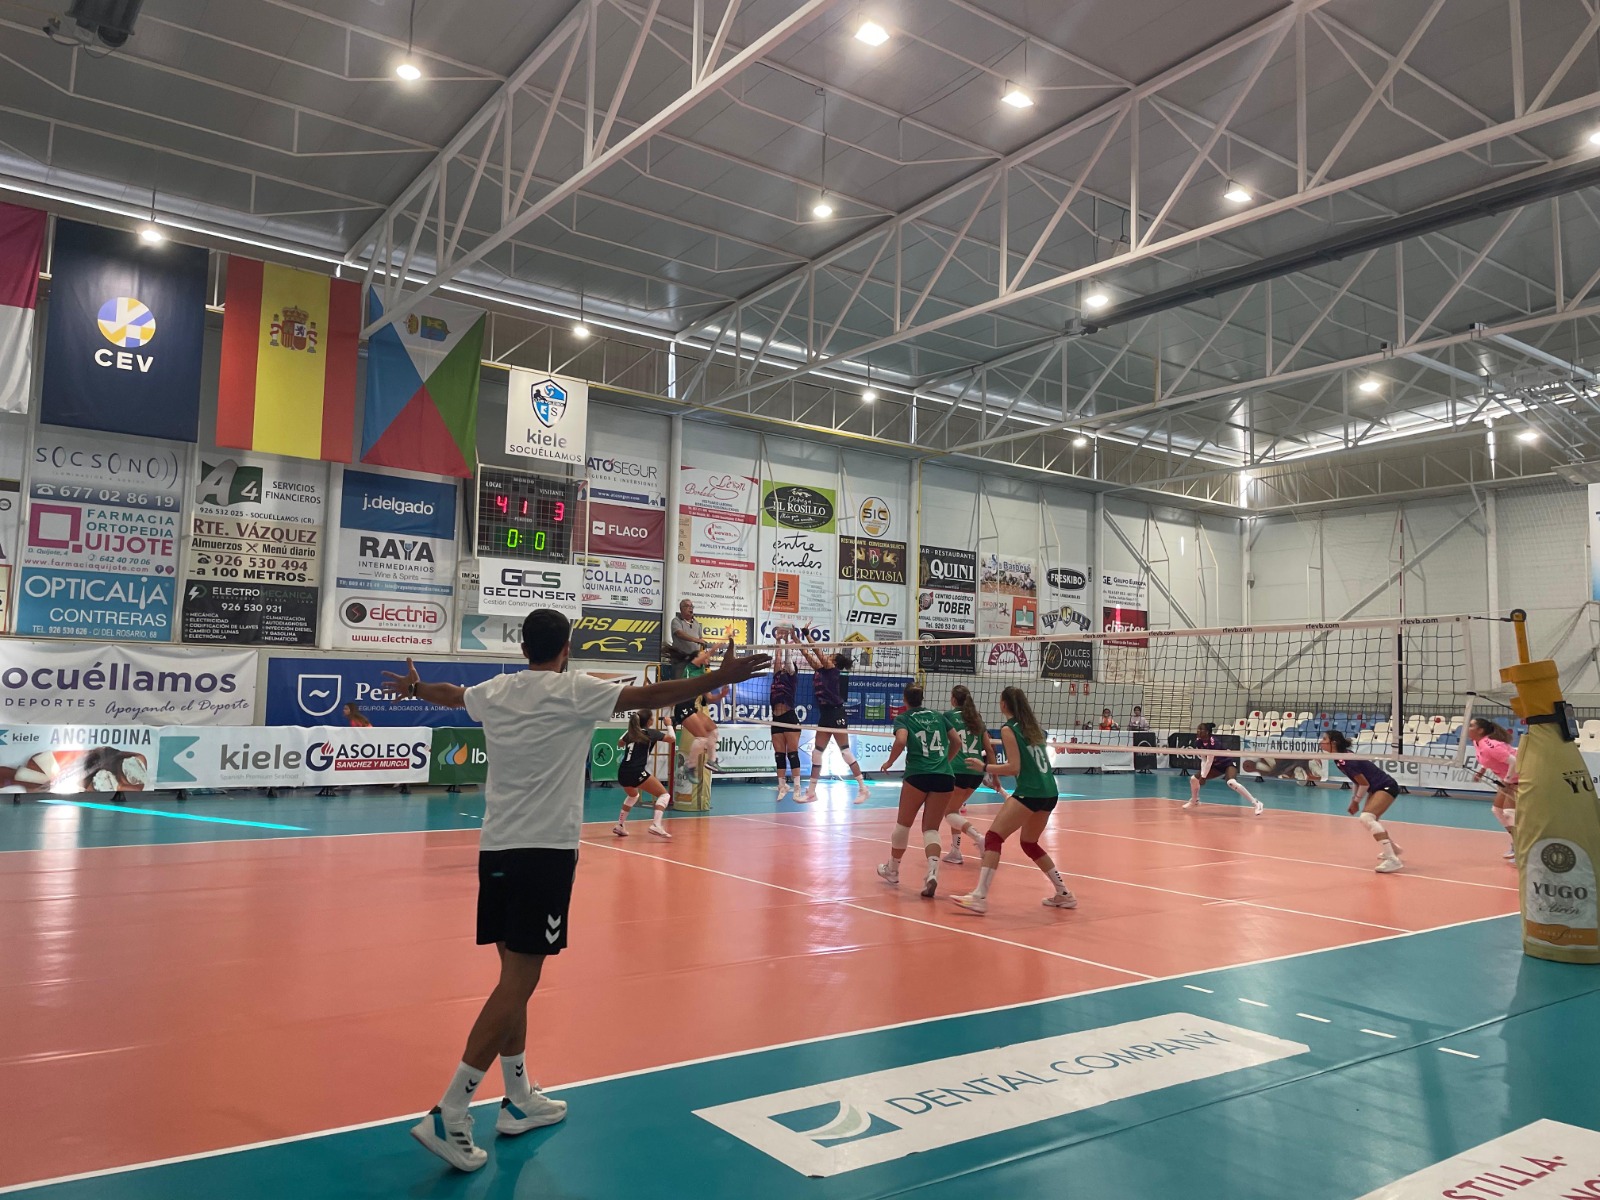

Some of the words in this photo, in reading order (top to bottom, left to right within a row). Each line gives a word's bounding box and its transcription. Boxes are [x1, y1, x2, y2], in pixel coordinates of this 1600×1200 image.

[95, 348, 154, 373] CEV
[526, 428, 568, 449] kiele
[509, 444, 582, 463] SOCUÉLLAMOS
[273, 481, 315, 493] SERVICIOS
[485, 481, 503, 489] LOCAL
[60, 485, 93, 499] 677
[99, 489, 120, 502] 02
[127, 492, 148, 504] 86
[156, 495, 174, 508] 19
[265, 491, 321, 504] FINANCIEROS
[362, 493, 433, 515] j.delgado
[215, 508, 229, 516] 532
[301, 517, 315, 525] (CR)
[496, 495, 508, 514] 4
[553, 501, 565, 522] 3
[787, 502, 826, 516] ROSILLO
[863, 508, 888, 521] SIC
[87, 509, 175, 526] FARMACIA
[86, 522, 174, 538] ORTOPEDIA
[193, 518, 229, 536] RTE.
[236, 522, 317, 544] VÁZQUEZ
[608, 524, 648, 539] FLACO
[192, 538, 243, 551] Almuerzos
[262, 544, 288, 555] Menú
[290, 545, 316, 558] diario
[360, 536, 434, 563] RAYA
[773, 531, 823, 553] entre
[934, 549, 975, 560] RESTAURANTE
[24, 558, 149, 573] www.farmaciaquijote.com
[215, 554, 243, 567] 926
[249, 557, 276, 569] 530
[281, 559, 308, 572] 494
[358, 561, 434, 573] INTERMEDIARIOS
[930, 558, 974, 580] QUINI
[211, 567, 239, 578] 100
[399, 573, 419, 581] Spirits
[501, 568, 561, 589] GCS
[842, 565, 904, 583] CEREVISIA
[1050, 573, 1083, 585] FRESKIBO
[483, 586, 577, 602] GECONSER
[584, 583, 622, 592] QUINARIA
[221, 602, 241, 611] 926
[243, 603, 263, 612] 530
[266, 604, 282, 613] 931
[483, 598, 507, 606] Gestión
[938, 601, 971, 616] TOBER
[50, 607, 167, 627] CONTRERAS
[369, 604, 437, 624] electria
[1400, 616, 1439, 625] rfevb.com
[49, 626, 61, 634] 926
[1222, 626, 1253, 634] rfevb.com
[1305, 622, 1339, 630] rfevb.com
[352, 634, 433, 645] www.electria.es
[1064, 648, 1091, 658] DULCES
[2, 661, 236, 693] ocuéllamos
[5, 698, 96, 707] DEPORTES
[105, 700, 175, 720] Apoyando
[181, 699, 193, 711] el
[198, 698, 250, 716] Deporte
[12, 732, 40, 743] kiele
[50, 728, 151, 746] ANCHODINA
[914, 730, 945, 758] 14
[958, 729, 979, 755] 12
[865, 742, 893, 752] Socué
[1270, 740, 1323, 752] ANCHODINA
[220, 743, 301, 770] kiele
[336, 760, 373, 769] SANCHEZ
[380, 760, 409, 768] MURCIA
[1562, 775, 1595, 793] YU
[1533, 881, 1588, 900] YUGO
[884, 1067, 1059, 1116] DENTAL
[1049, 1028, 1231, 1076] COMPANY
